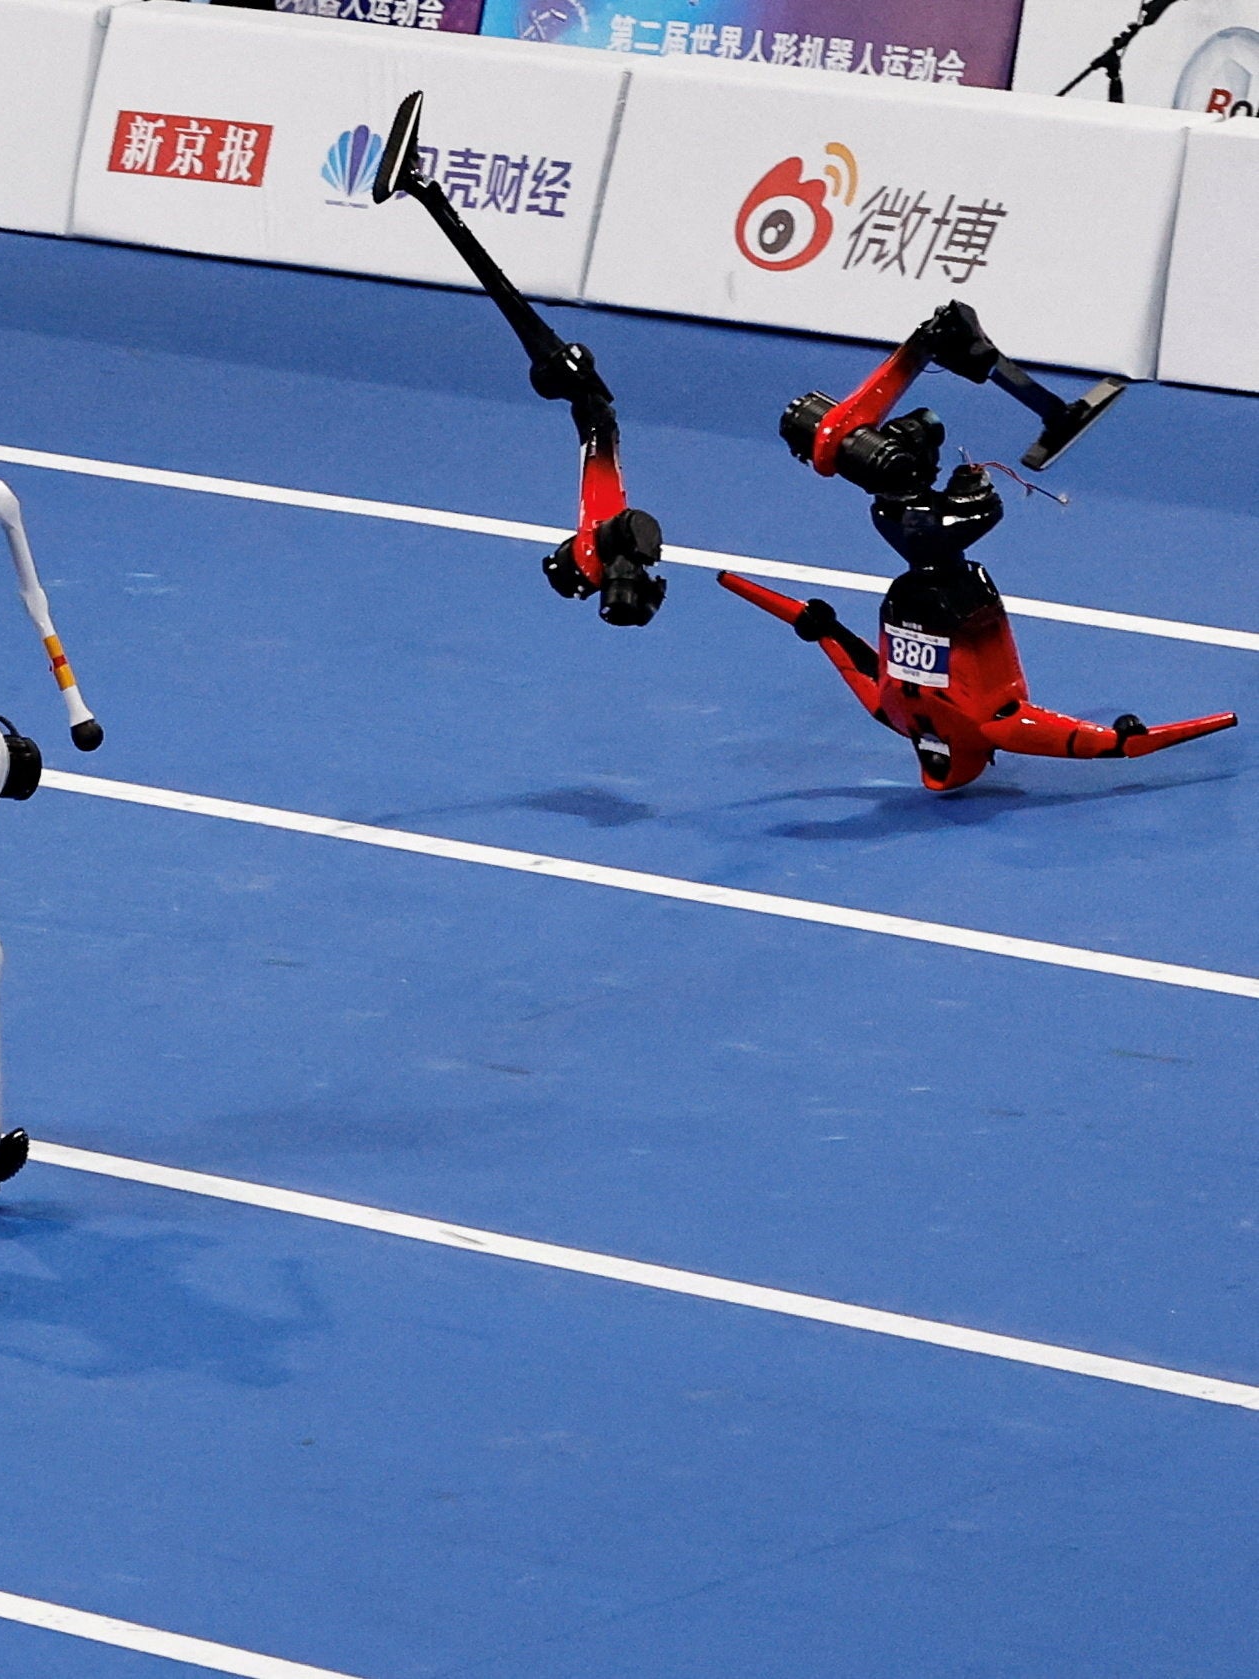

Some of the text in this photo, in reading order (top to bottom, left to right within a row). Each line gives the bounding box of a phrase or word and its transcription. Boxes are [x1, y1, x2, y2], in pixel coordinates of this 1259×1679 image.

[608, 13, 967, 86] 第二届世界人形机器人运动会
[119, 115, 260, 183] 新京报
[842, 184, 1009, 283] 微博
